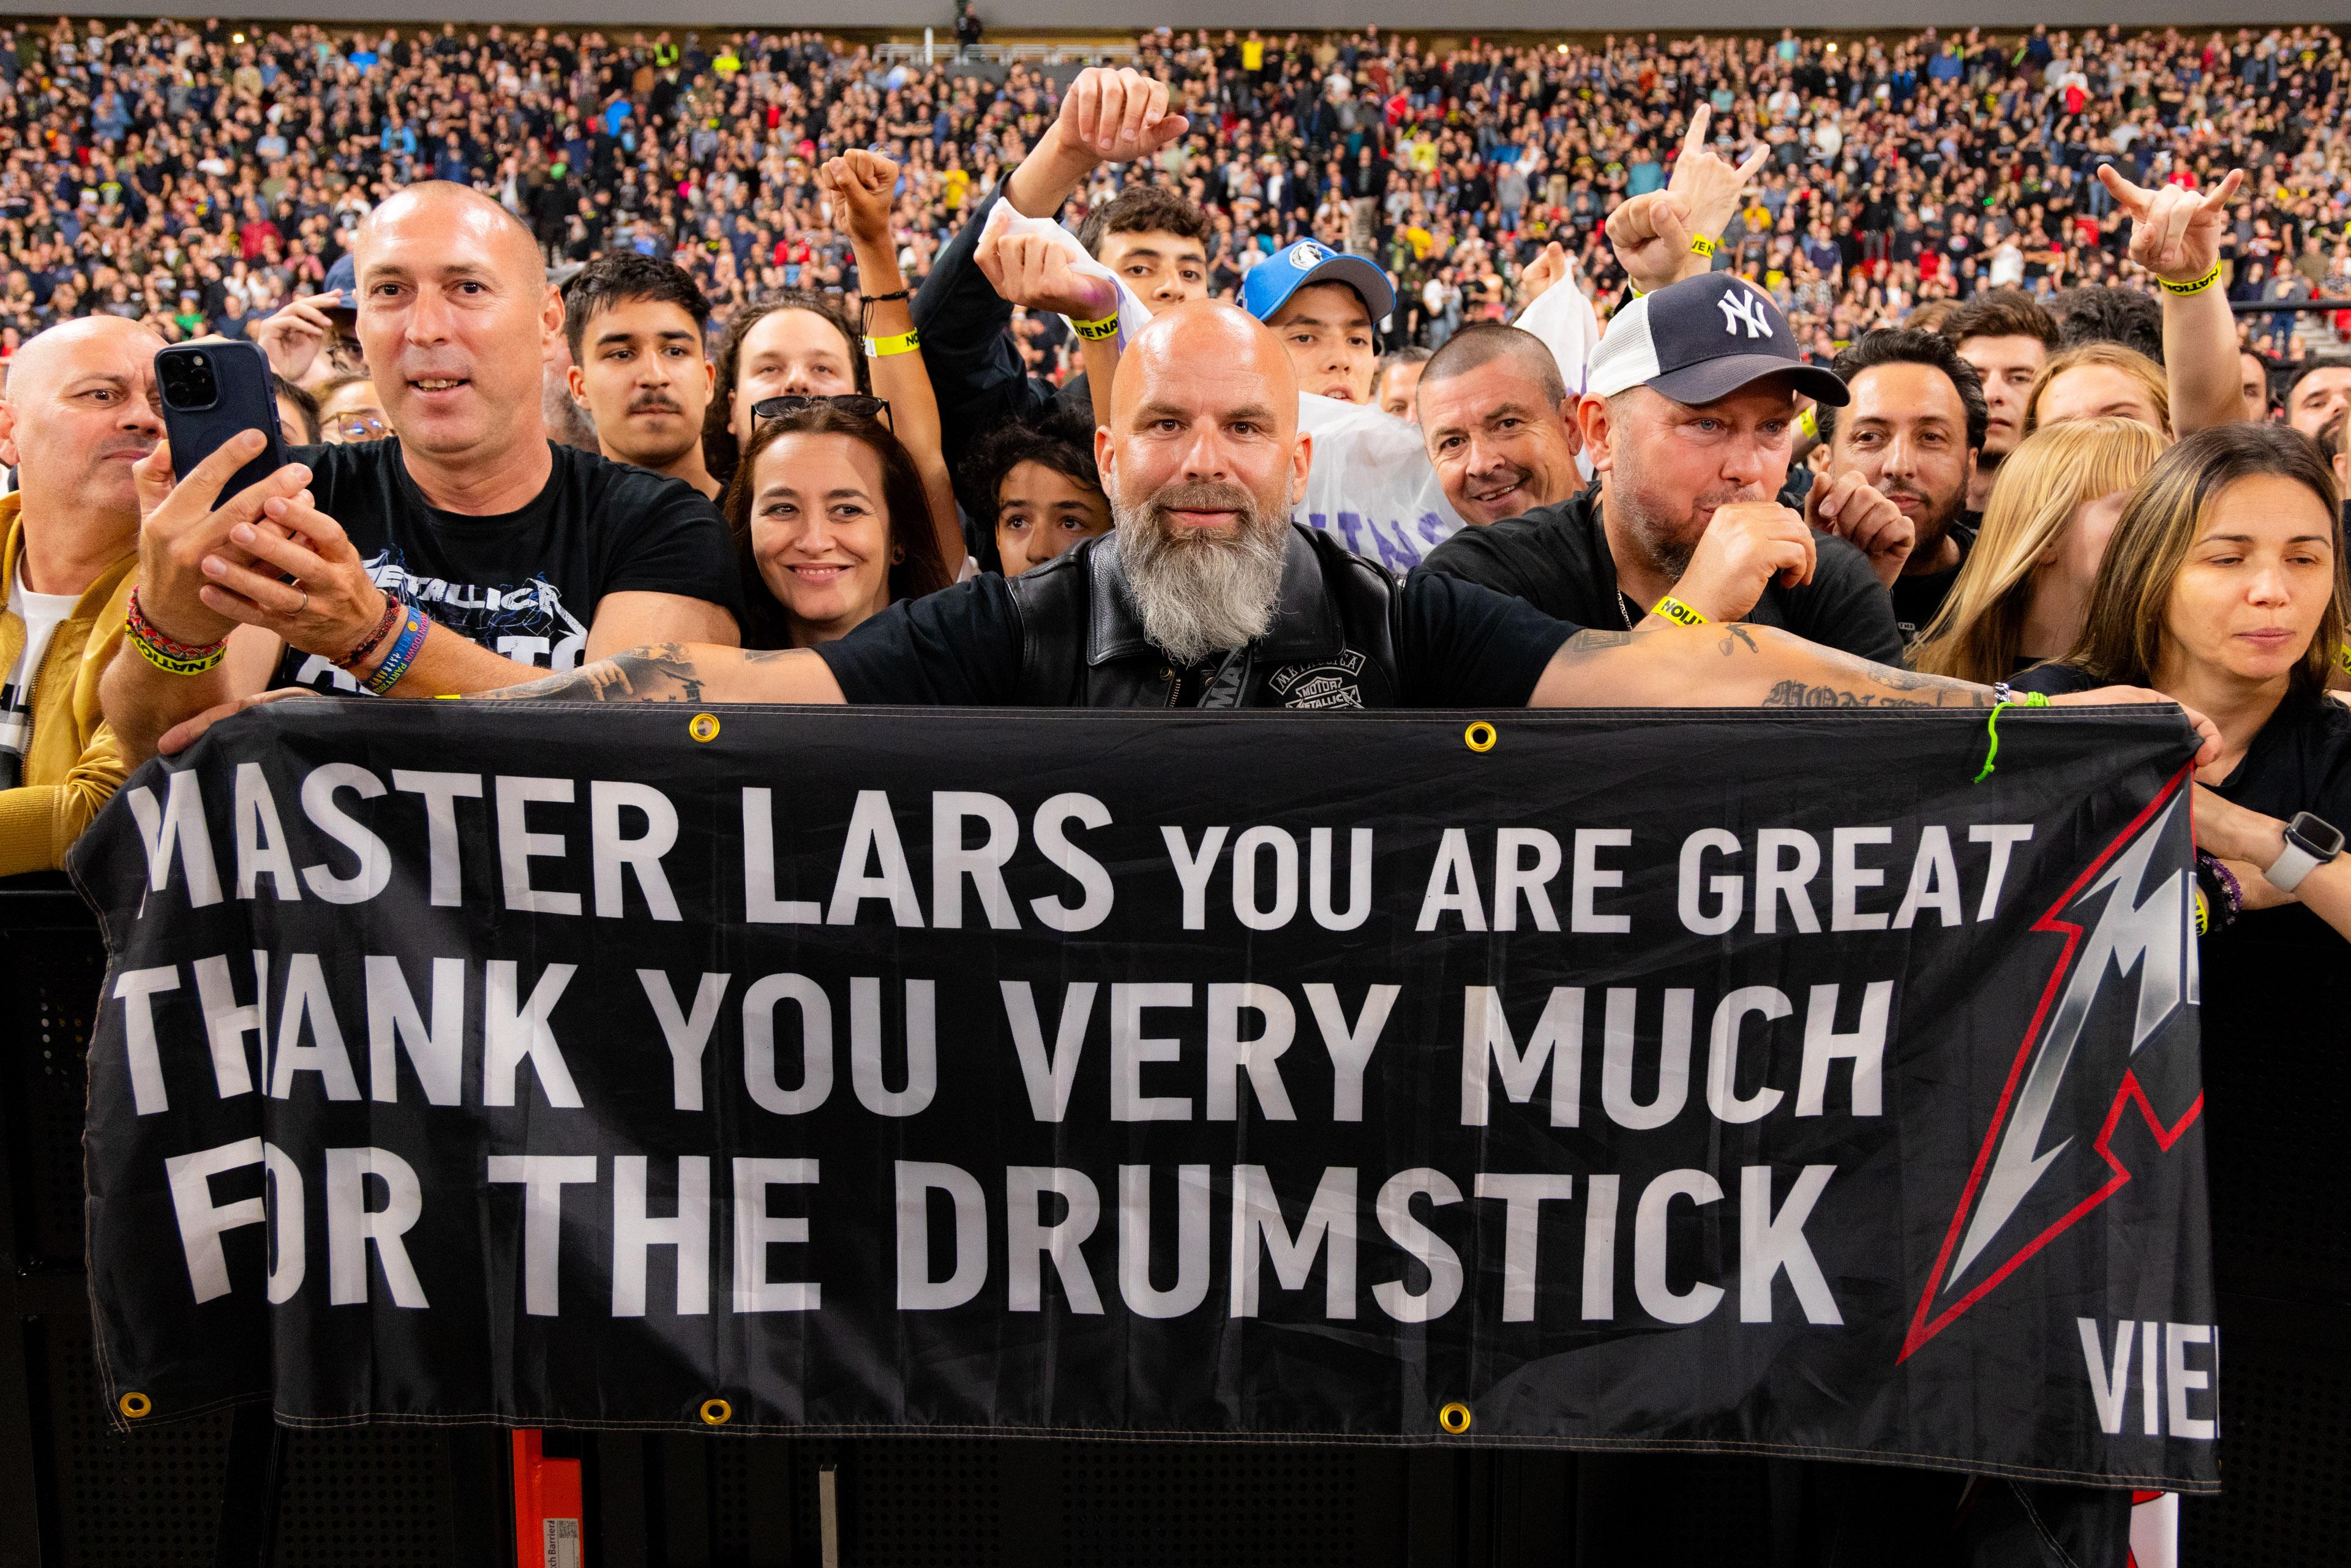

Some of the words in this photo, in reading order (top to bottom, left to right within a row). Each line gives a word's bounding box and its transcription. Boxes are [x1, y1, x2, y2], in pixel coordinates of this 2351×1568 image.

[1717, 288, 1774, 339] NY
[386, 662, 407, 686] PARTY
[1302, 680, 1338, 697] MOTOR
[127, 762, 683, 921] MASTER
[743, 787, 1114, 932] LARS
[1161, 825, 1373, 931] YOU
[1416, 828, 1632, 933] ARE
[1678, 824, 2034, 936] GREAT
[113, 950, 584, 1116] THANK
[637, 969, 937, 1117] YOU
[1000, 980, 1401, 1122] VERY
[1461, 980, 1894, 1130] MUCH
[165, 1136, 430, 1309] FOR
[488, 1155, 821, 1317] THE
[895, 1160, 1843, 1325] DRUMSTICK
[2077, 1317, 2220, 1440] VIE
